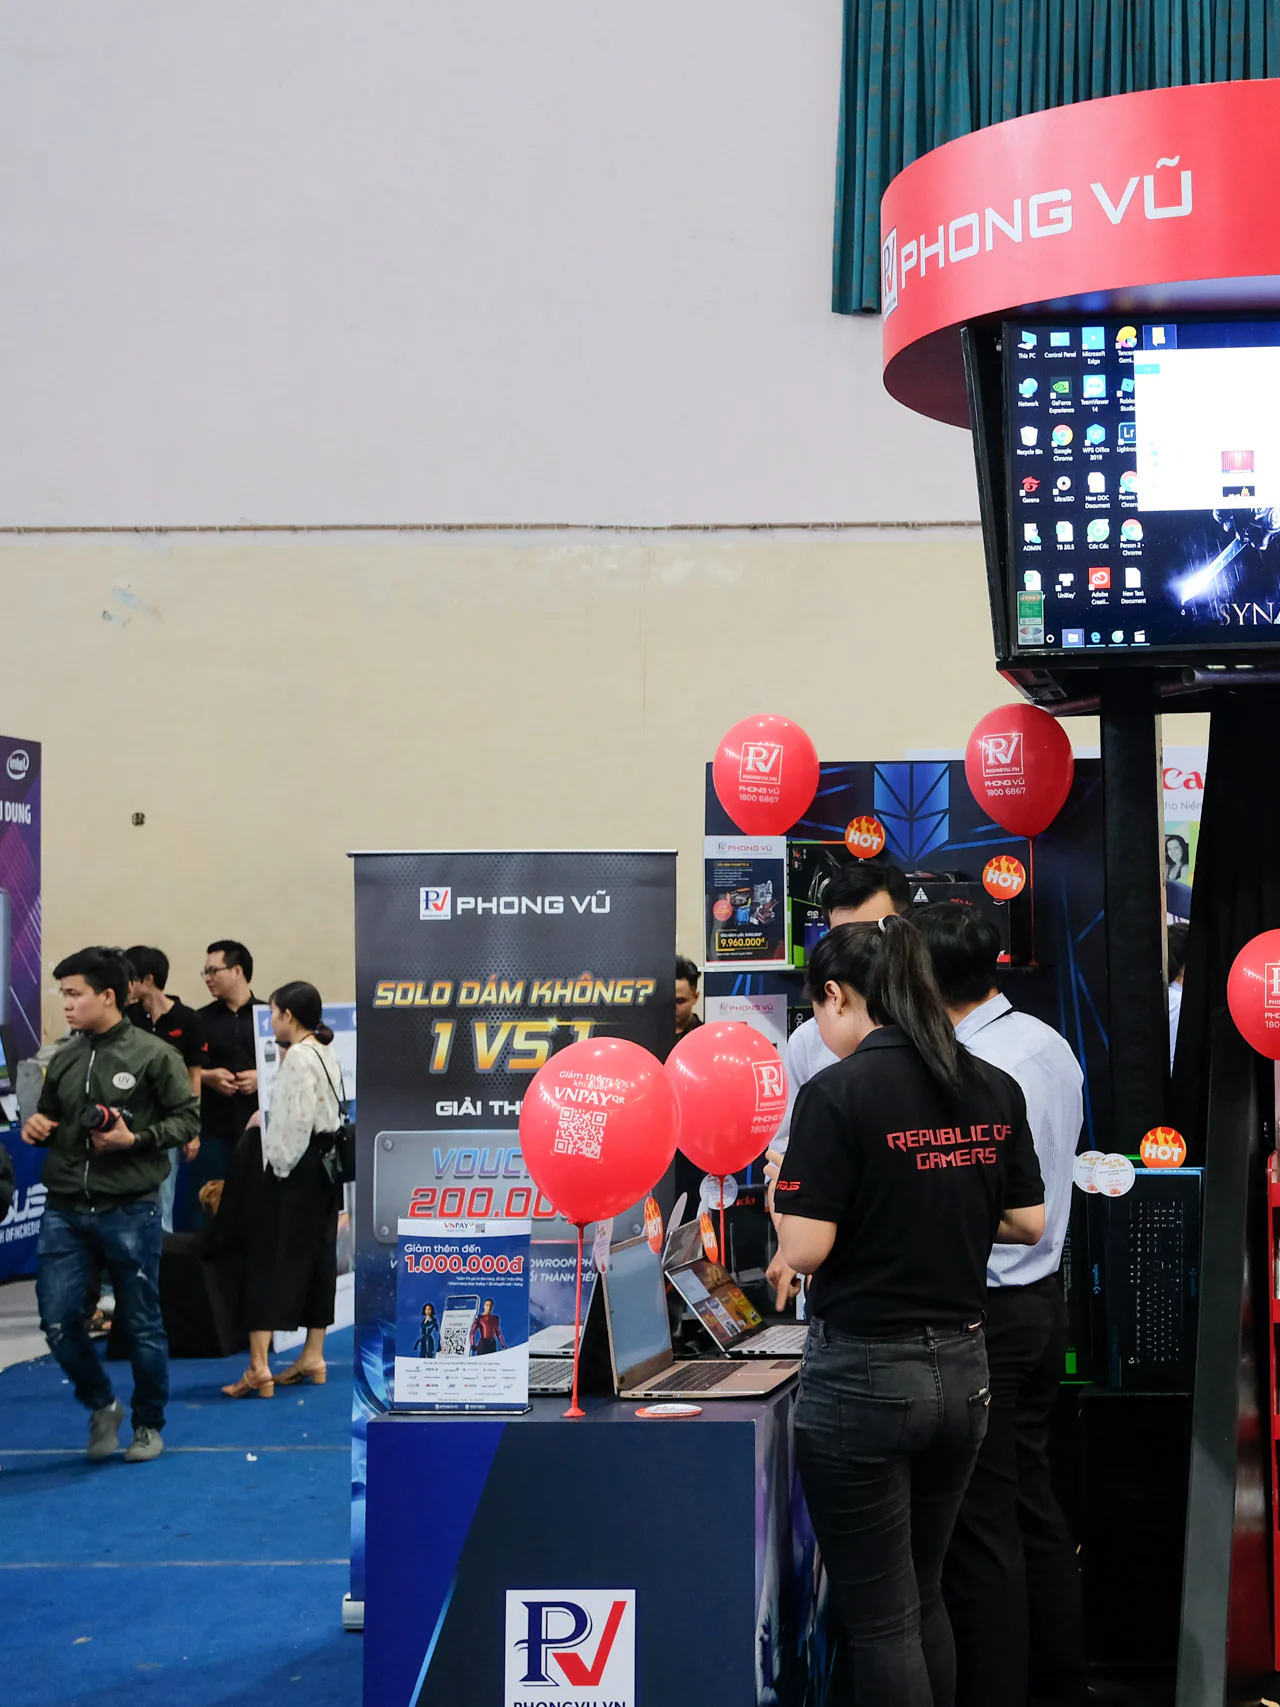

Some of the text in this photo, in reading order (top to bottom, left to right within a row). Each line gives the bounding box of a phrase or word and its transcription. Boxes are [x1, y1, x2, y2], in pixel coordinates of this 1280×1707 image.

[901, 155, 1192, 289] PHONG VŨ
[739, 786, 767, 794] PHONG
[739, 794, 779, 804] 1800 6867
[986, 787, 1026, 797] 1800 6867
[848, 830, 881, 850] HOT
[986, 870, 1022, 890] HOT
[457, 895, 564, 915] PHONG
[570, 890, 611, 914] VŨ
[374, 972, 655, 1006] SOLO DÁM KHÔNG?
[431, 1020, 554, 1072] 1 VS
[435, 1097, 482, 1116] GIẢI
[887, 1124, 1011, 1152] REPUBLIC OF
[916, 1147, 997, 1170] GAMERS
[1145, 1143, 1182, 1161] HOT
[432, 1147, 531, 1178] VOUC
[407, 1186, 568, 1219] 200.00
[647, 1220, 662, 1238] HOT
[404, 1244, 481, 1253] Giảm thêm đến
[404, 1254, 524, 1274] 1.000.000đ
